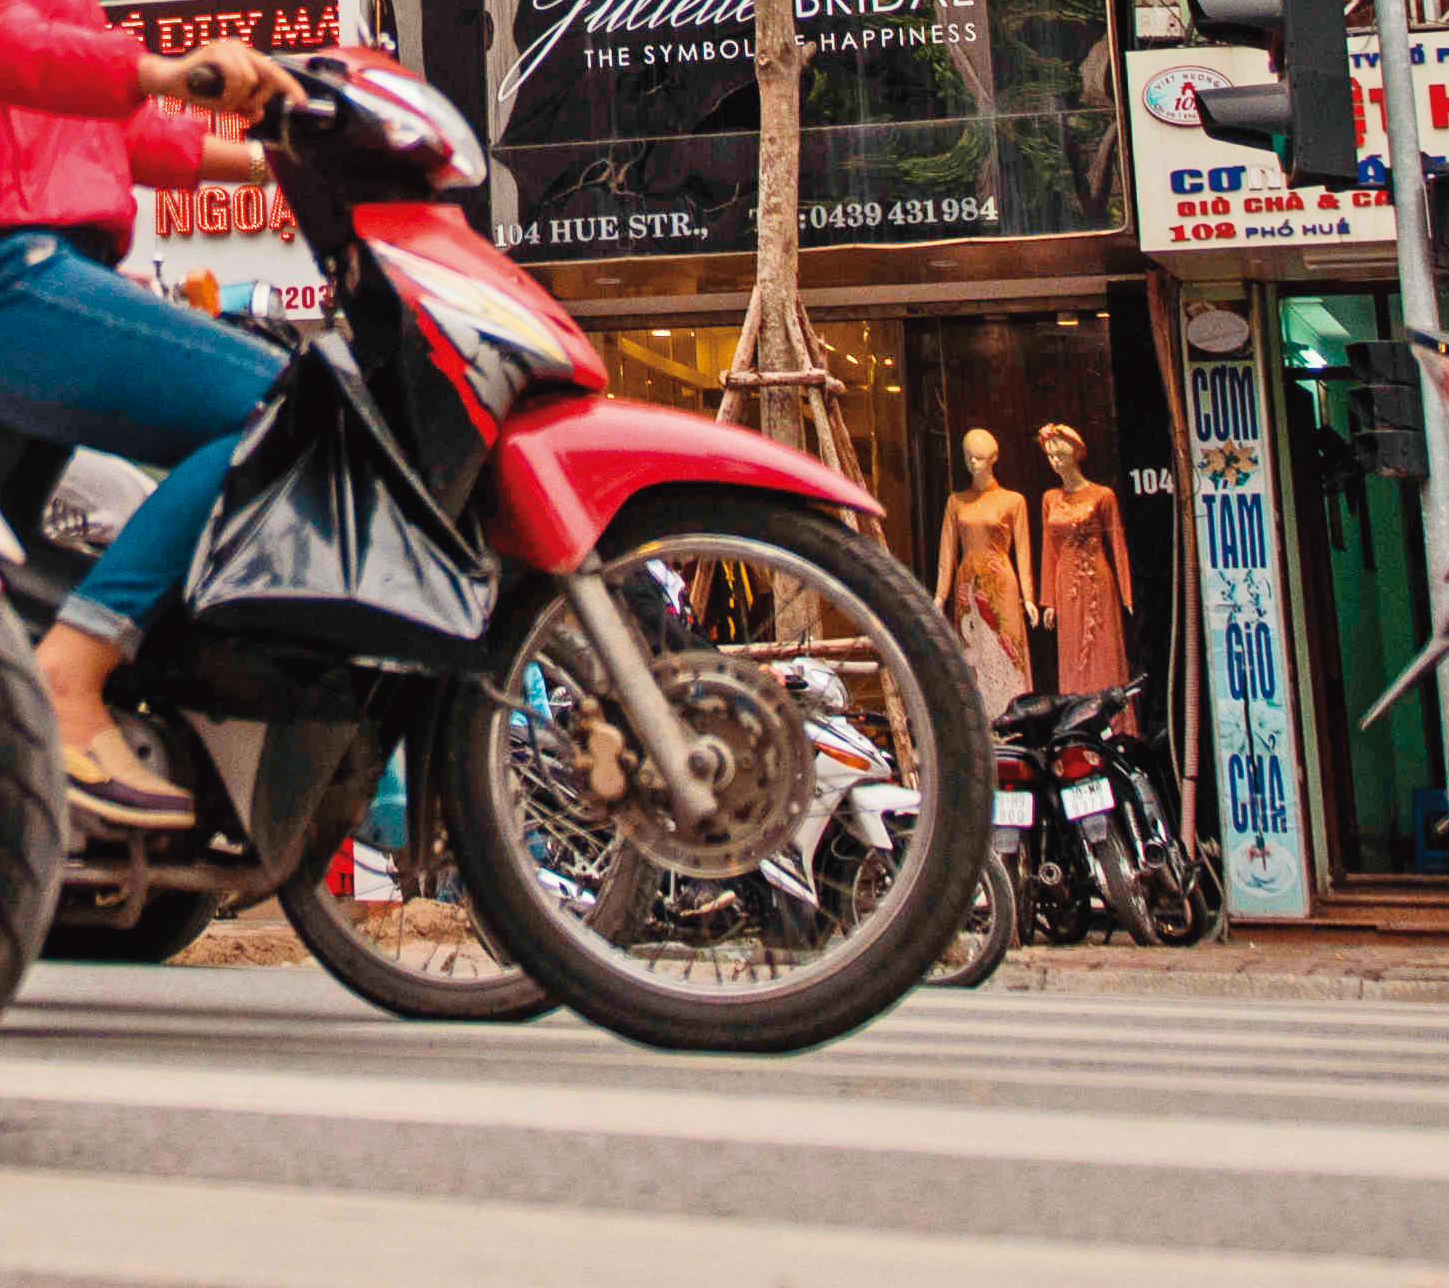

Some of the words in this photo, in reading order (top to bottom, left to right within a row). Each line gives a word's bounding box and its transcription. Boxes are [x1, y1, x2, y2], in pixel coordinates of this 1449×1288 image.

[583, 47, 631, 69] THE
[644, 38, 755, 65] SYMBOL
[820, 22, 977, 53] HAPPINESS
[1175, 96, 1197, 111] 10
[155, 184, 297, 242] NGOẠ
[1317, 193, 1340, 211] &
[495, 223, 541, 249] 104
[549, 216, 620, 245] HUE
[1169, 221, 1238, 243] 102
[1245, 219, 1295, 239] PHỐ
[1191, 362, 1259, 443] CƠM
[1130, 466, 1175, 495] 104
